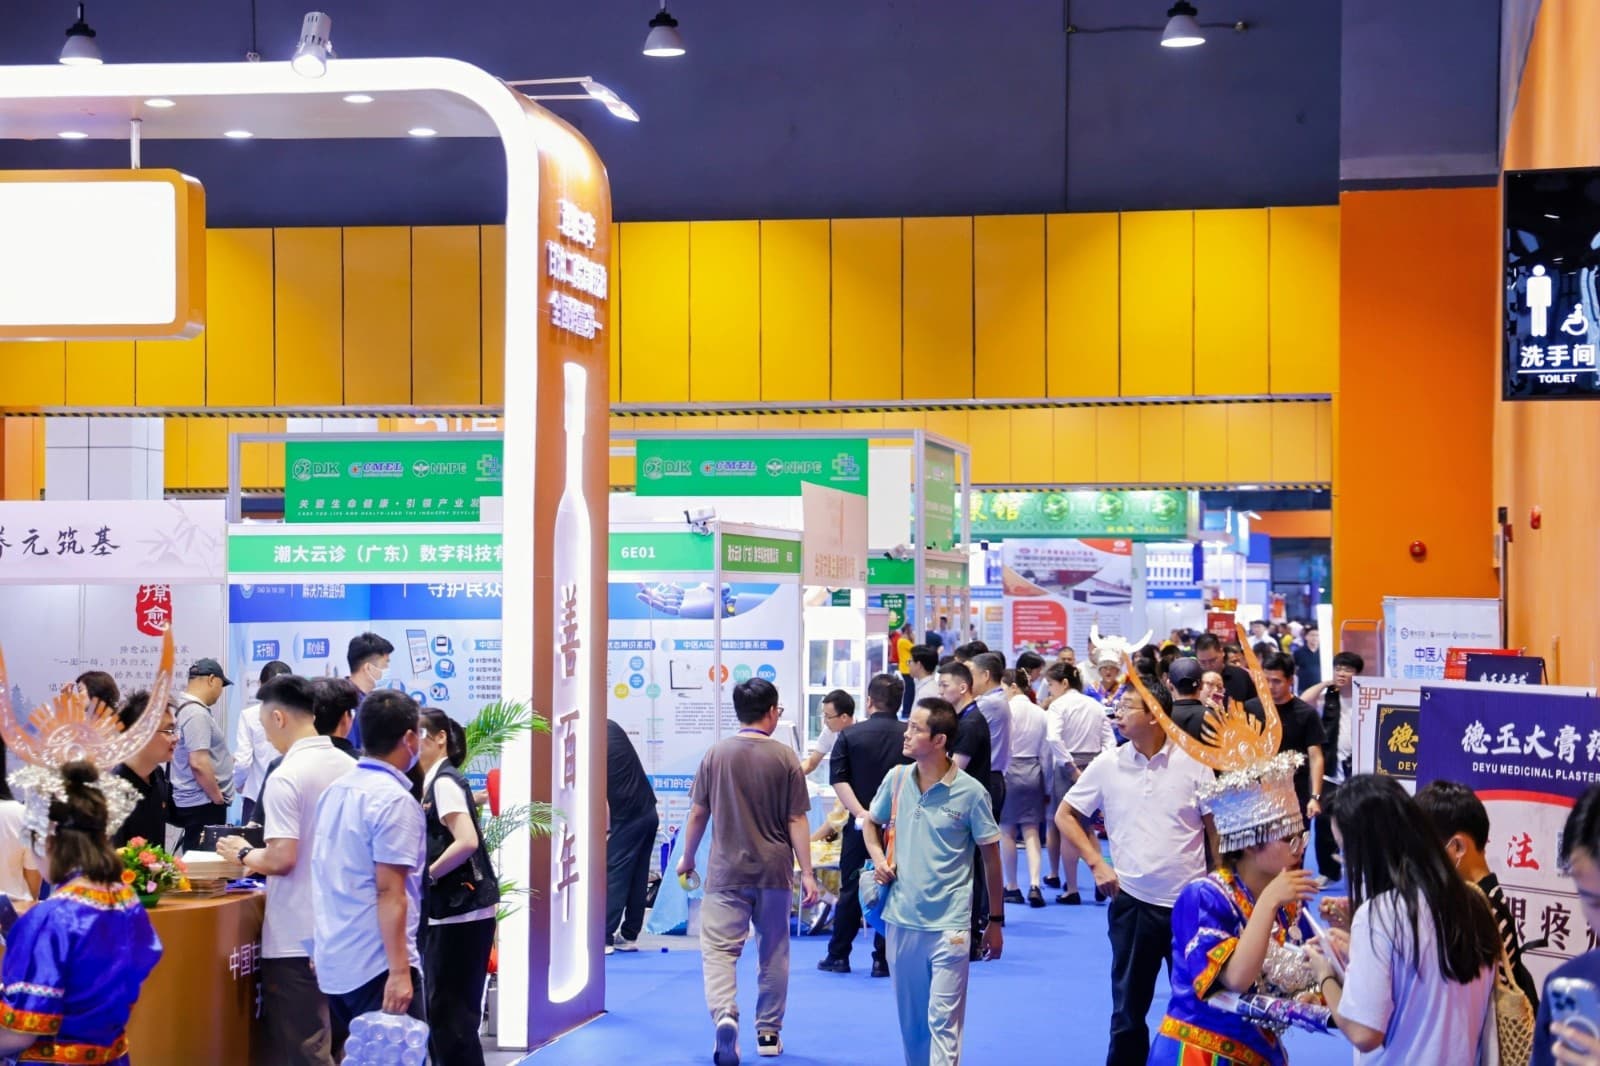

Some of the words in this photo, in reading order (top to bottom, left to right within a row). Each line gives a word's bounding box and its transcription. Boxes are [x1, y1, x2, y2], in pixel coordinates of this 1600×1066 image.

[1520, 343, 1596, 368] 洗手间
[1538, 373, 1577, 384] TOILET
[313, 462, 340, 474] DJK
[430, 462, 467, 474] NHPE
[664, 460, 692, 473] DJK
[783, 461, 822, 474] NHPE
[620, 546, 656, 559] 6E01
[1387, 722, 1419, 754] 德
[1472, 761, 1498, 774] DEYU
[1500, 764, 1554, 779] MEDICINAL
